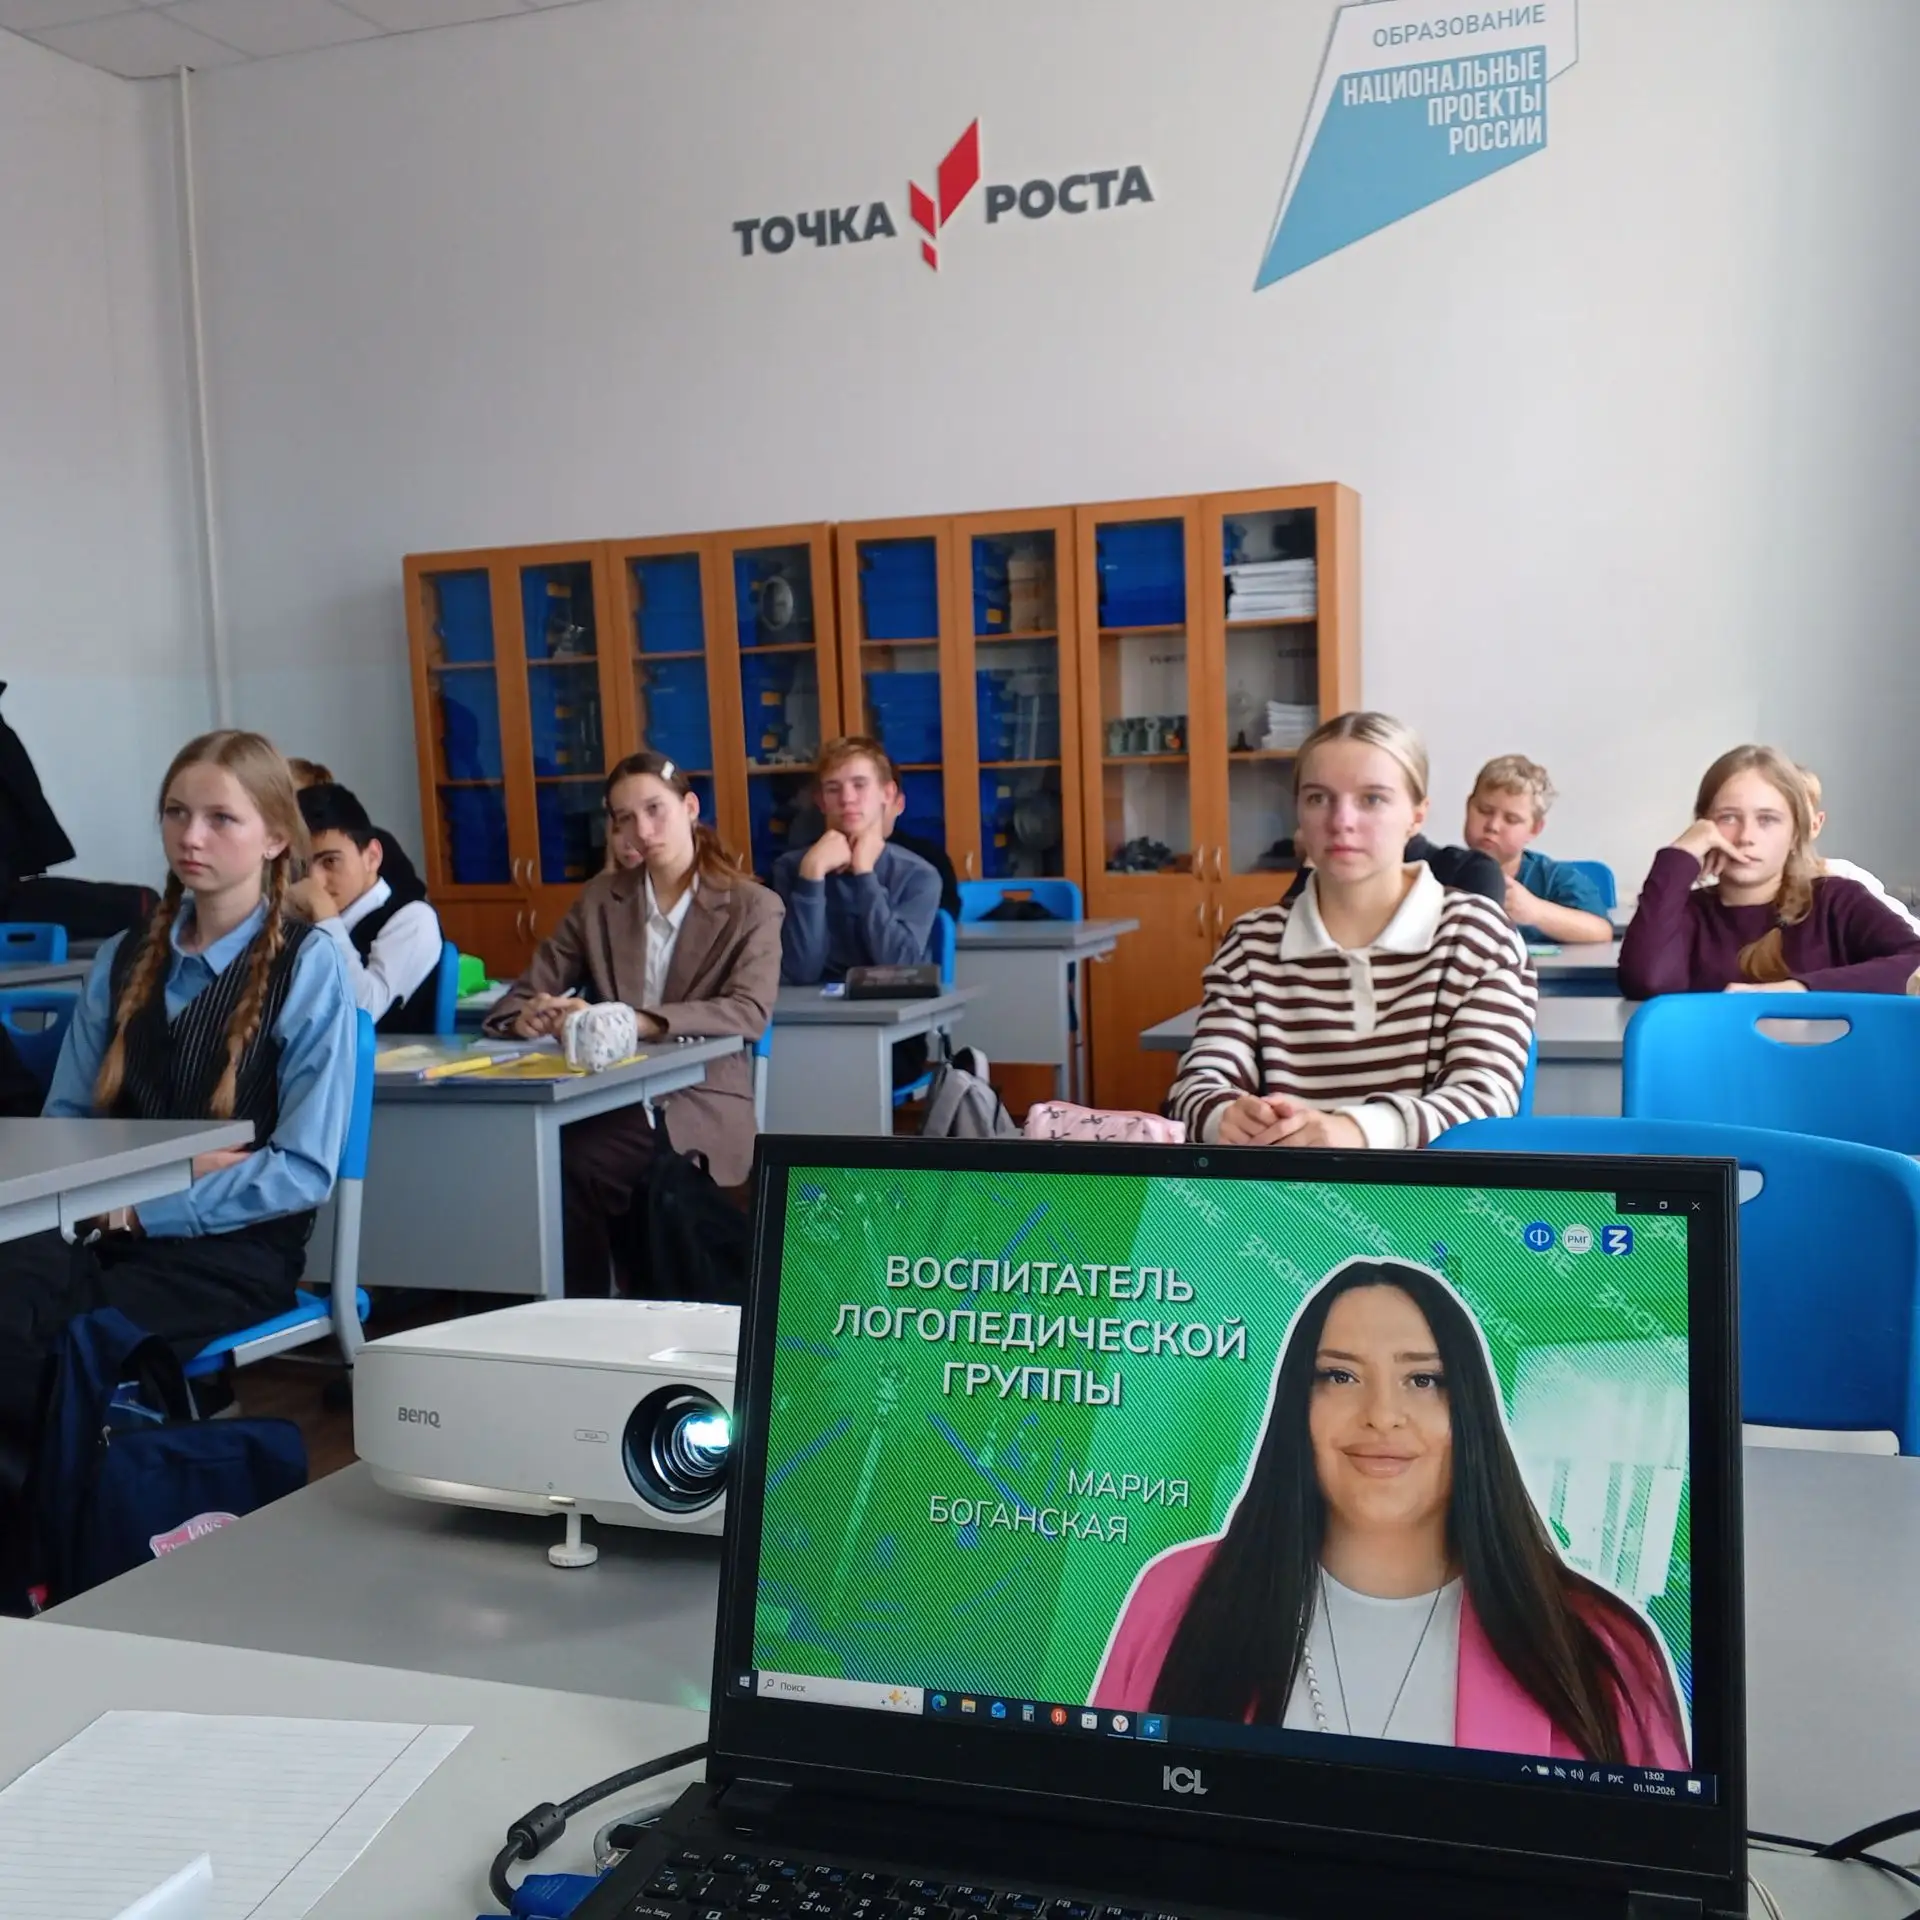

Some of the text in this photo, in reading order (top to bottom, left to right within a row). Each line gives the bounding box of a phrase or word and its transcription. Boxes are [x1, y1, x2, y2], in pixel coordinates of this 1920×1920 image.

[1373, 3, 1546, 47] ОБРАЗОВАНИЕ
[1342, 51, 1542, 106] НАЦИОНАЛЬНЫЕ
[1428, 84, 1542, 126] ПРОЕКТЫ
[1449, 116, 1543, 155] РОССИИ
[733, 165, 1155, 256] ТОЧКА РОСТА
[1567, 1235, 1588, 1244] РМГ
[886, 1255, 1194, 1303] ВОСПИТАТЕЛЬ
[832, 1303, 1247, 1361] ЛОГОПЕДИЧЕСКОЙ
[942, 1362, 1123, 1407] ГРУППЫ
[397, 1406, 441, 1428] BenQ
[1068, 1468, 1190, 1508] МАРИЯ
[929, 1495, 1129, 1544] БОГАНСКАЯ
[780, 1682, 806, 1693] Поиск
[1162, 1765, 1208, 1795] ICL
[1608, 1774, 1624, 1784] РУС
[1633, 1783, 1676, 1796] 01.10.2026
[1644, 1771, 1665, 1782] 13:02
[769, 1859, 784, 1867] F2
[815, 1866, 830, 1874] F3
[862, 1872, 875, 1881] F4
